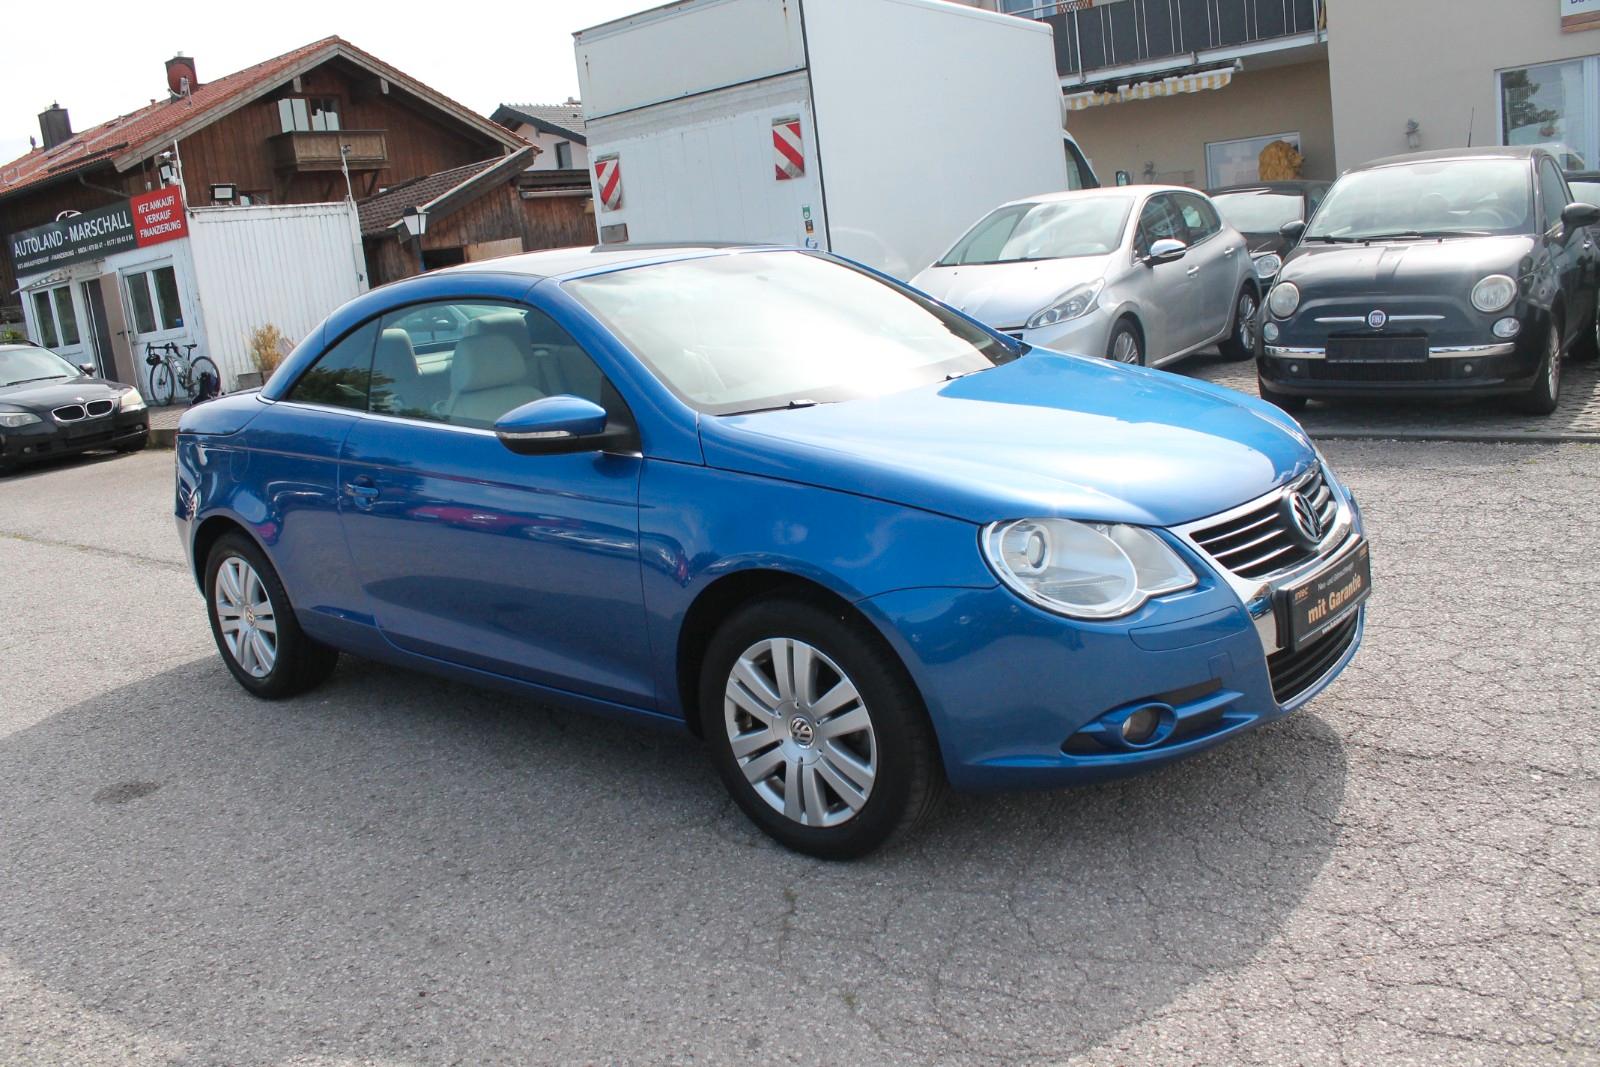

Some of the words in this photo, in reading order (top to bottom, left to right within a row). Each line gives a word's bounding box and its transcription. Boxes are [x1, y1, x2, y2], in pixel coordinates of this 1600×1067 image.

[140, 219, 181, 238] FINANZIERUNG
[144, 209, 171, 224] VERKAUF
[14, 231, 63, 258] AUTOLAND
[69, 211, 131, 243] MARSCHALL
[1308, 598, 1327, 624] mit
[1328, 572, 1361, 610] Garantie
